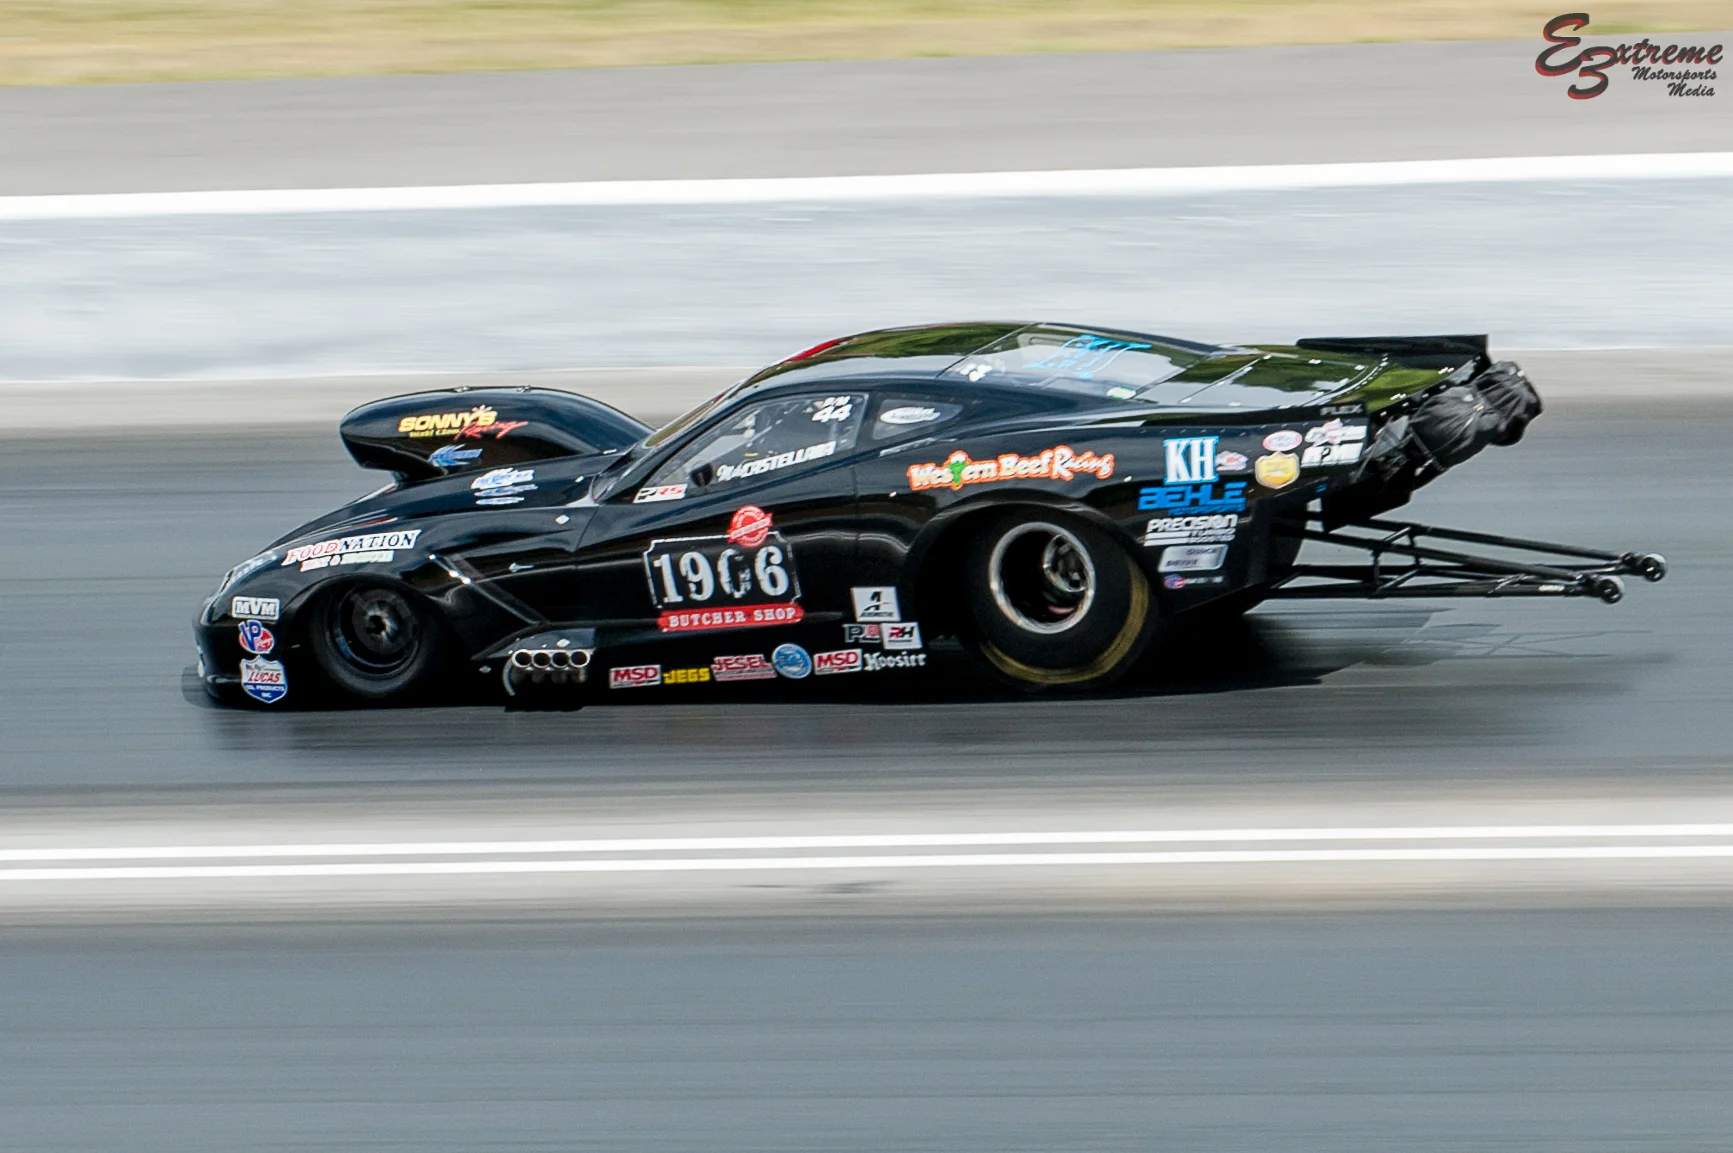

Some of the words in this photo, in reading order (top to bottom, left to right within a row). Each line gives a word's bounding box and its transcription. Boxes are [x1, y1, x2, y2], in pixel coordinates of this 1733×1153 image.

[398, 410, 498, 433] SONNY'S
[811, 404, 853, 422] 44
[999, 453, 1053, 476] Beef
[1163, 437, 1220, 483] KH
[234, 599, 278, 617] MVM
[668, 611, 746, 628] BUTCHER
[753, 607, 796, 622] SHOP
[714, 655, 769, 672] JESEL
[817, 652, 859, 668] MSD
[248, 672, 282, 683] LUCAS
[614, 667, 658, 681] MSD
[664, 668, 711, 684] JEGS
